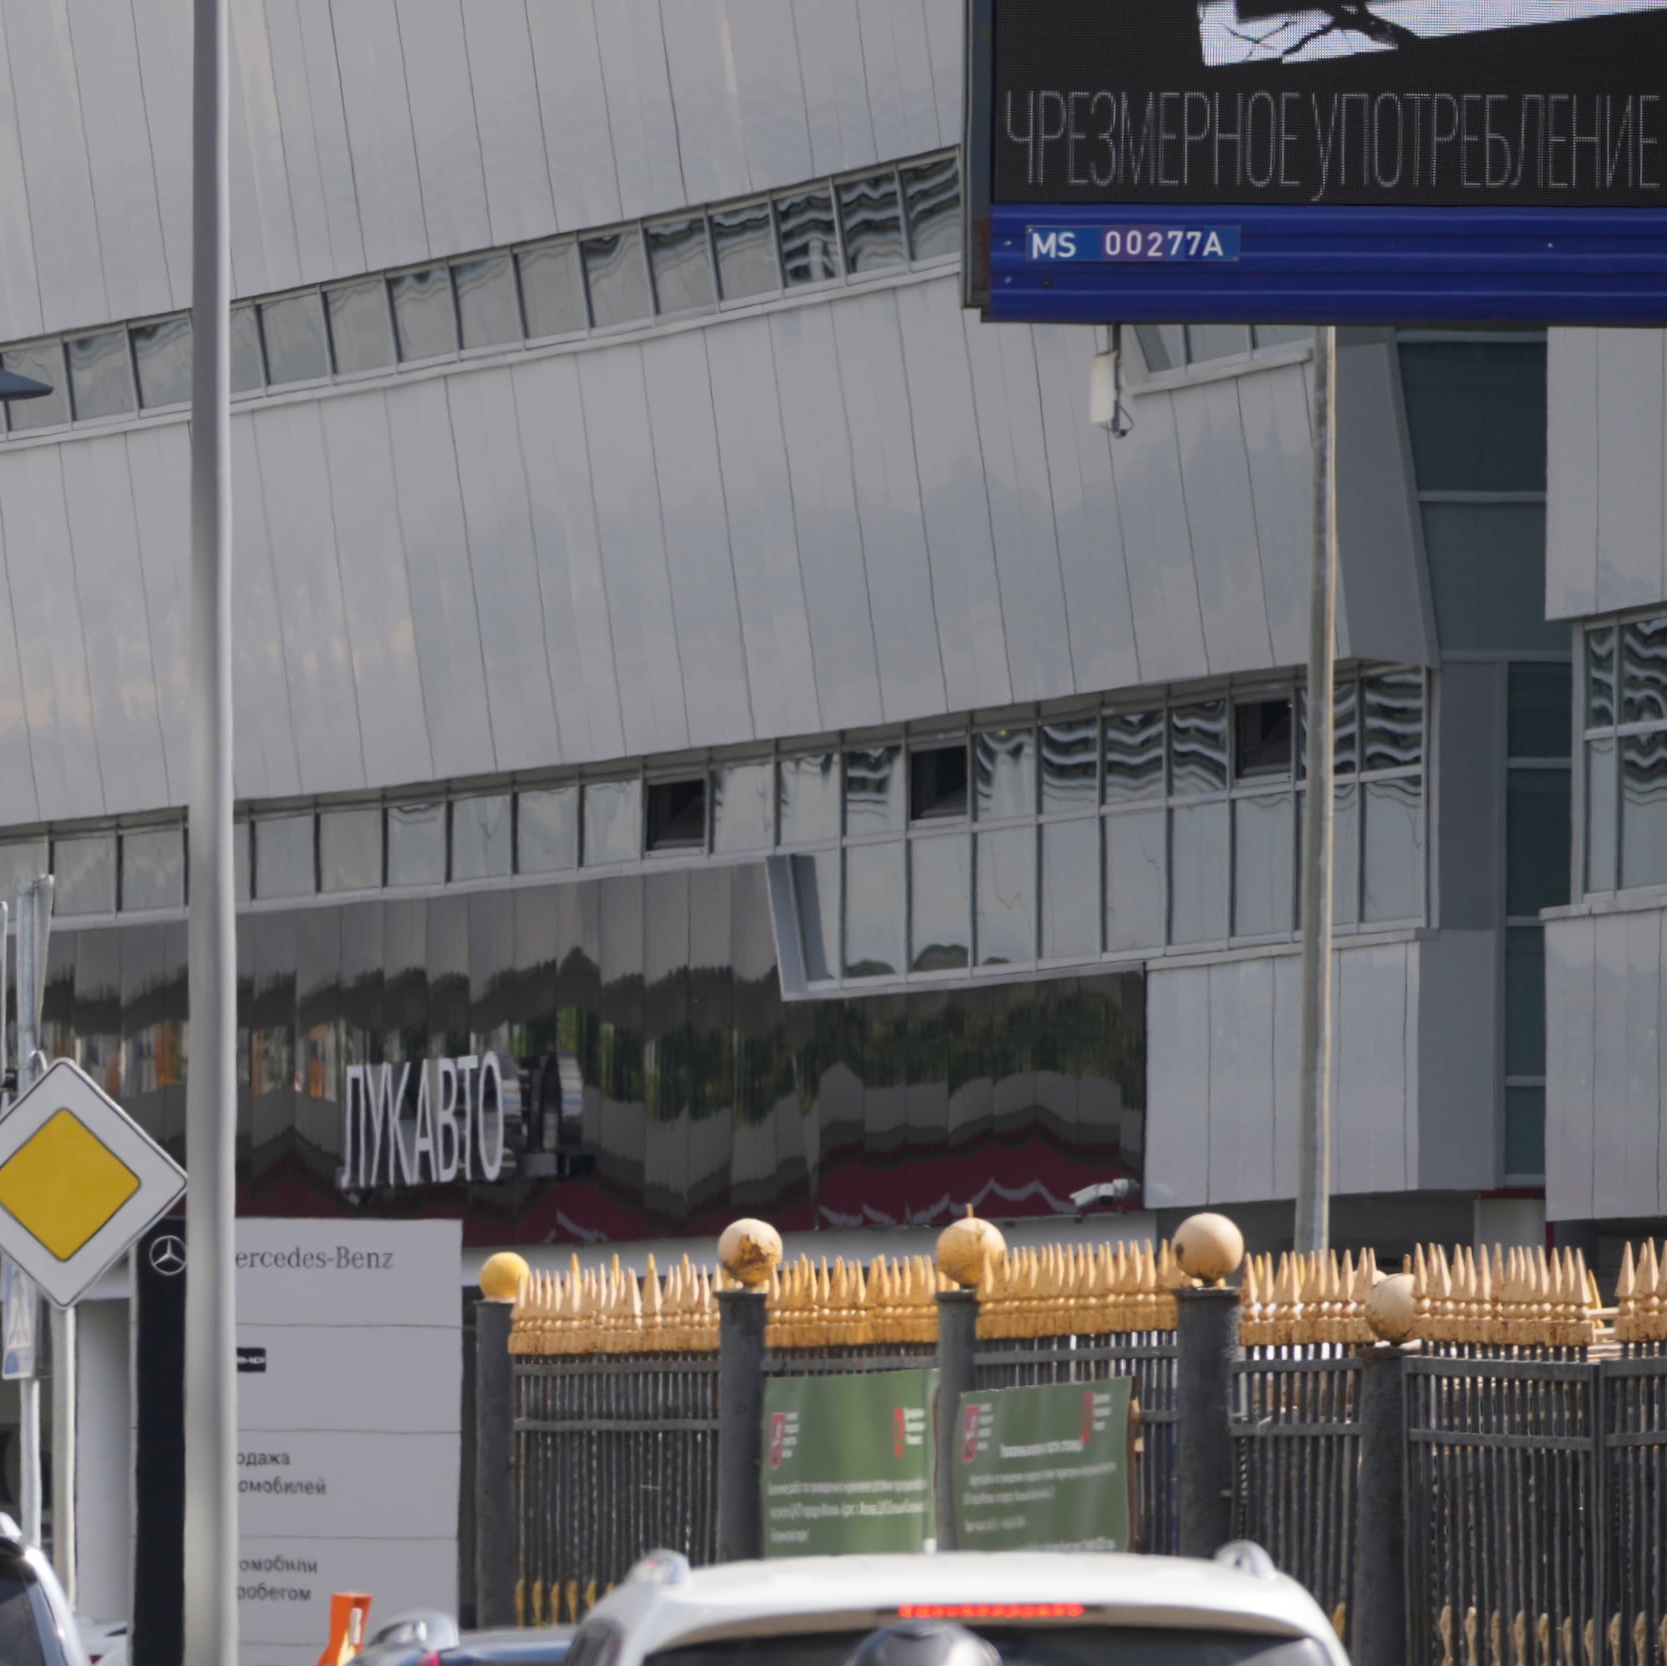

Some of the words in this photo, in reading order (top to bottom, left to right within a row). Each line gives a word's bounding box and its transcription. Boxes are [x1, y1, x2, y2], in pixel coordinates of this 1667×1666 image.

[1006, 90, 1302, 188] ЧРЕЗМЕРНОЕ
[1310, 91, 1661, 202] УПОТРЕБЛЕНИЕ
[1031, 231, 1077, 259] MS
[1104, 230, 1224, 257] 00277A
[341, 1051, 505, 1190] ЛУКАВТО
[235, 1245, 395, 1270] ercedes-Benz
[237, 1476, 327, 1495] омобилей
[238, 1555, 318, 1574] омобили
